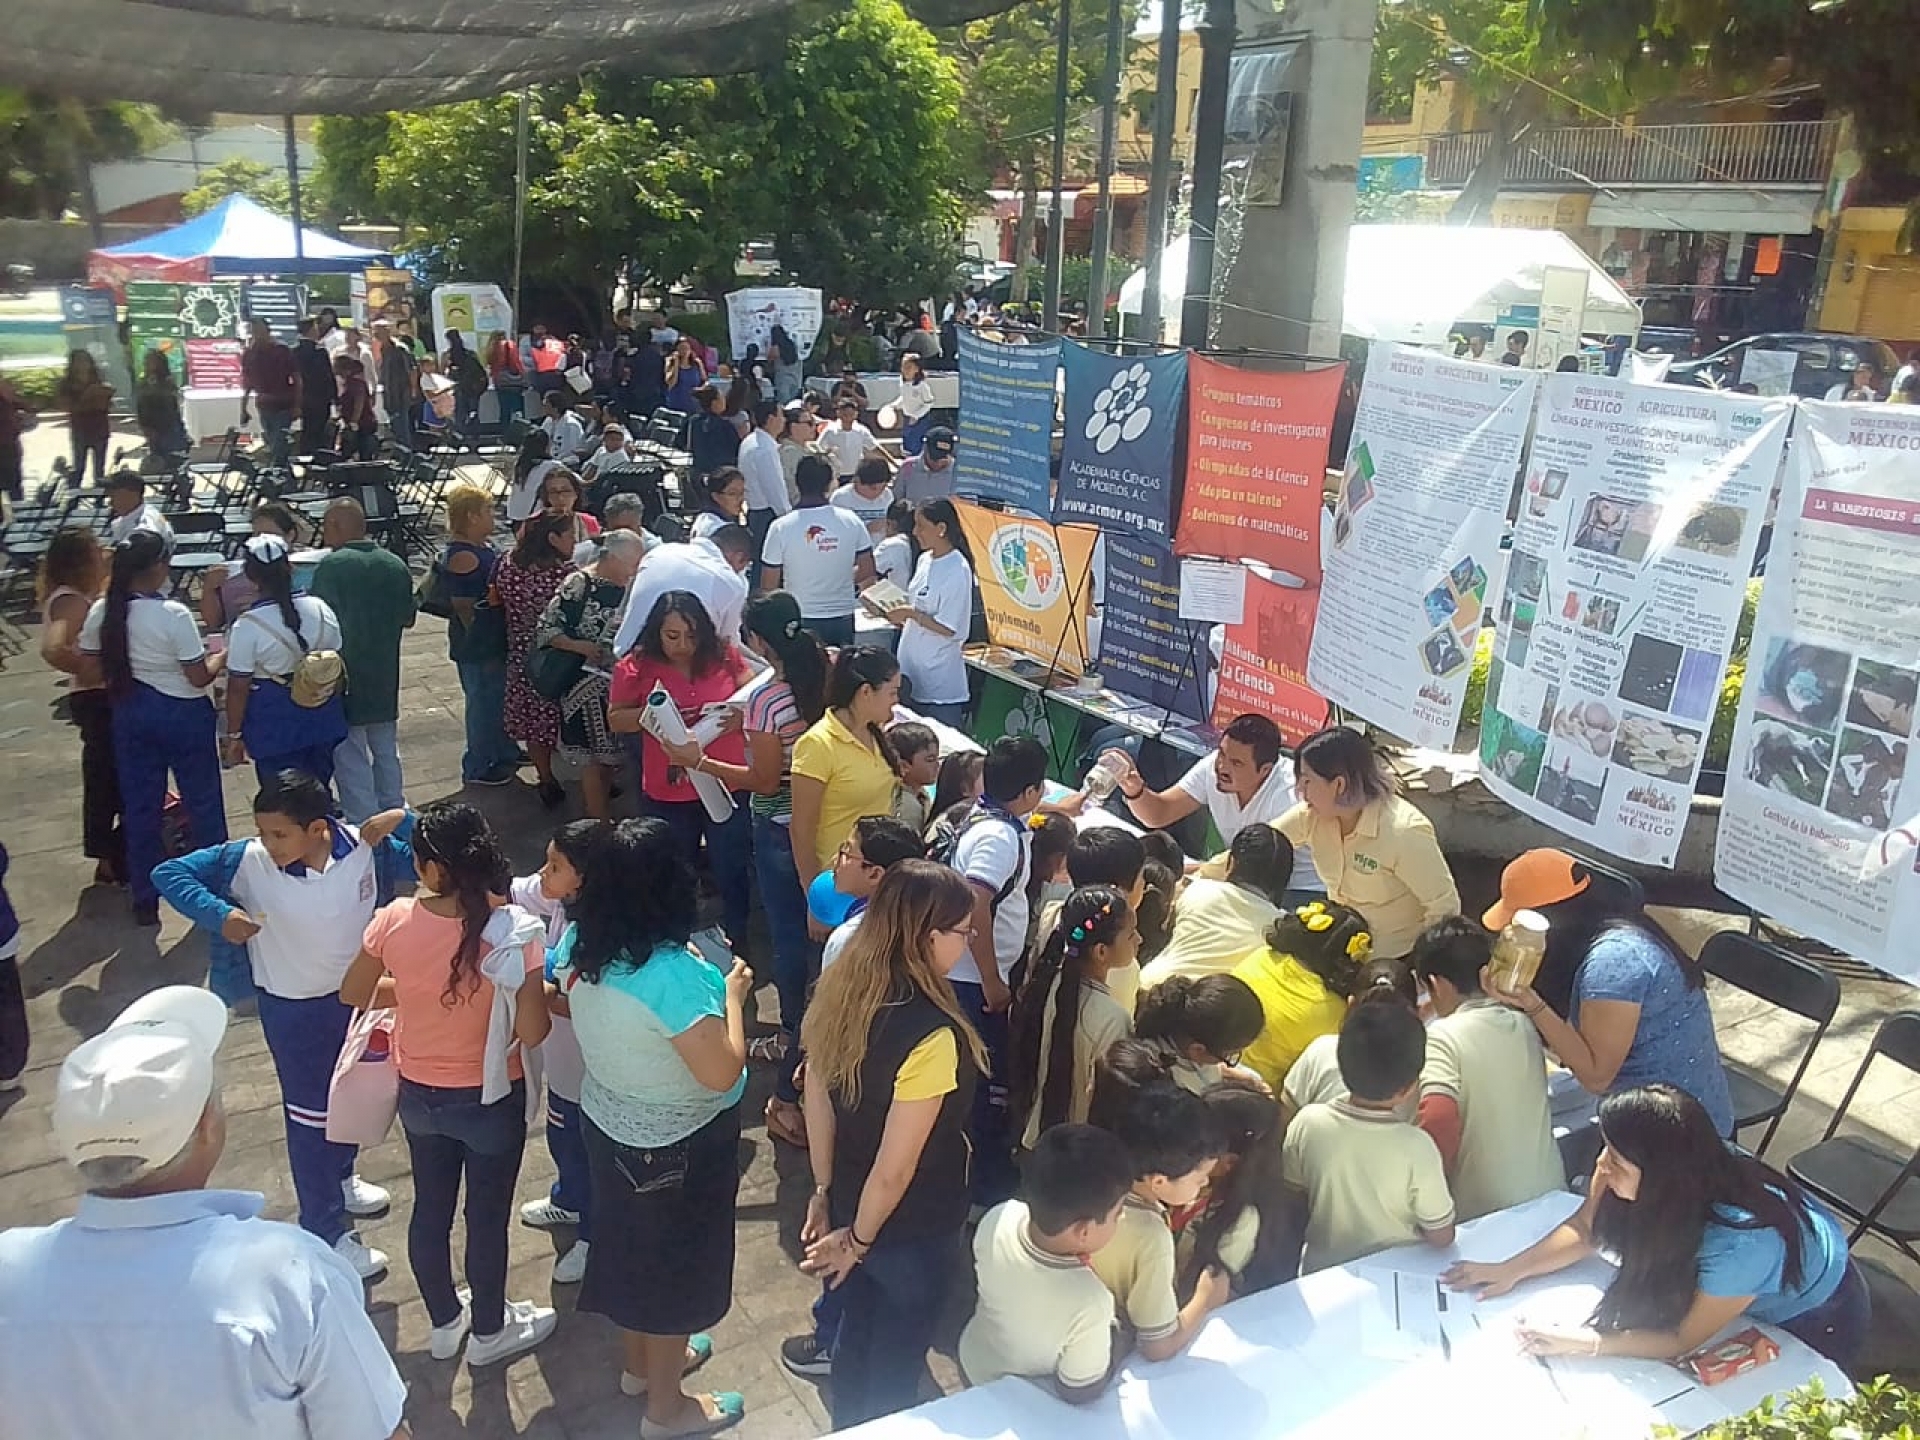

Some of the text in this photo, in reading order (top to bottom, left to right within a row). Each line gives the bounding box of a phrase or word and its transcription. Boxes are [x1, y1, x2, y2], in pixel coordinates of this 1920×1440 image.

[1236, 392, 1282, 409] temáticos
[1571, 397, 1622, 415] MÉXICO
[1636, 401, 1717, 421] AGRICULTURA
[1250, 419, 1261, 433] de
[1199, 433, 1218, 448] para
[1847, 429, 1920, 451] MÉXICO
[1069, 459, 1161, 490] ACADEMIA DE CIENCIAS
[1076, 478, 1087, 489] DE
[1251, 465, 1263, 479] de
[1265, 467, 1274, 481] la
[1275, 467, 1309, 487] Ciencia
[1232, 491, 1245, 502] un
[1061, 499, 1165, 535] www.acmor.org.mx
[1832, 501, 1906, 522] BABESIOSIS
[1237, 514, 1249, 528] de
[1250, 518, 1309, 541] matemáticas
[986, 608, 1042, 635] Diplomado
[1222, 659, 1275, 696] La Ciencia
[1616, 813, 1675, 837] MÉXICO
